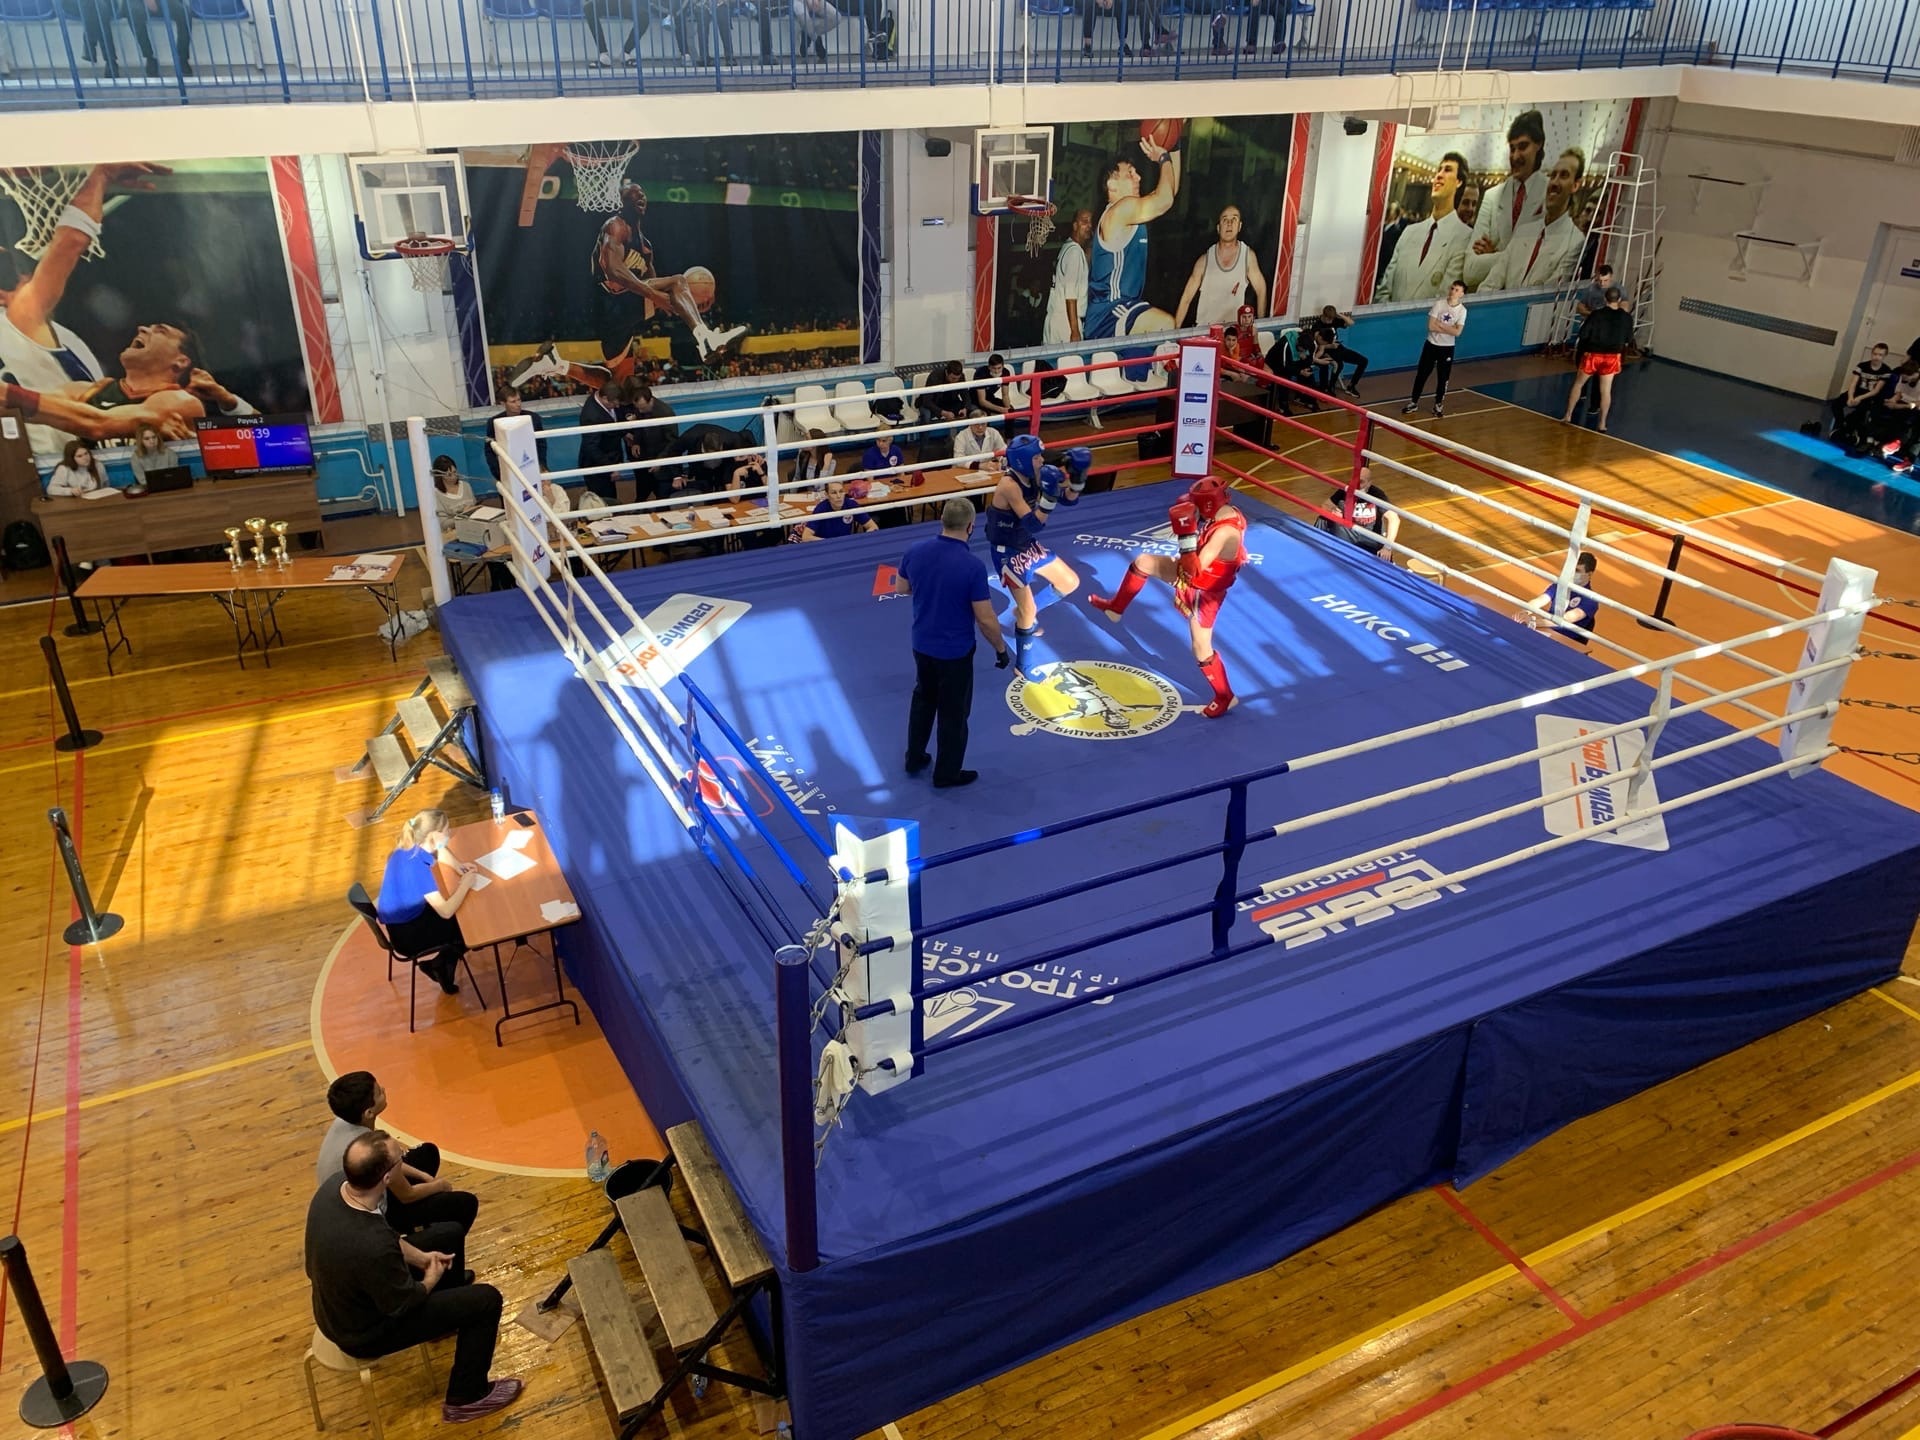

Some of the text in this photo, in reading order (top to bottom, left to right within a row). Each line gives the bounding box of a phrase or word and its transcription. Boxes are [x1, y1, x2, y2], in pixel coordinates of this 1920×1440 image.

[236, 428, 271, 440] 00:39
[1310, 594, 1411, 641] НИКС
[1094, 662, 1173, 693] ЧЕЛЯБИНСКАЯ
[1010, 695, 1049, 729] ТАЙСКОГО
[1142, 695, 1178, 731] ОБЛАСТНАЯ
[1054, 726, 1138, 738] ФЕДЕРАЦИЯ
